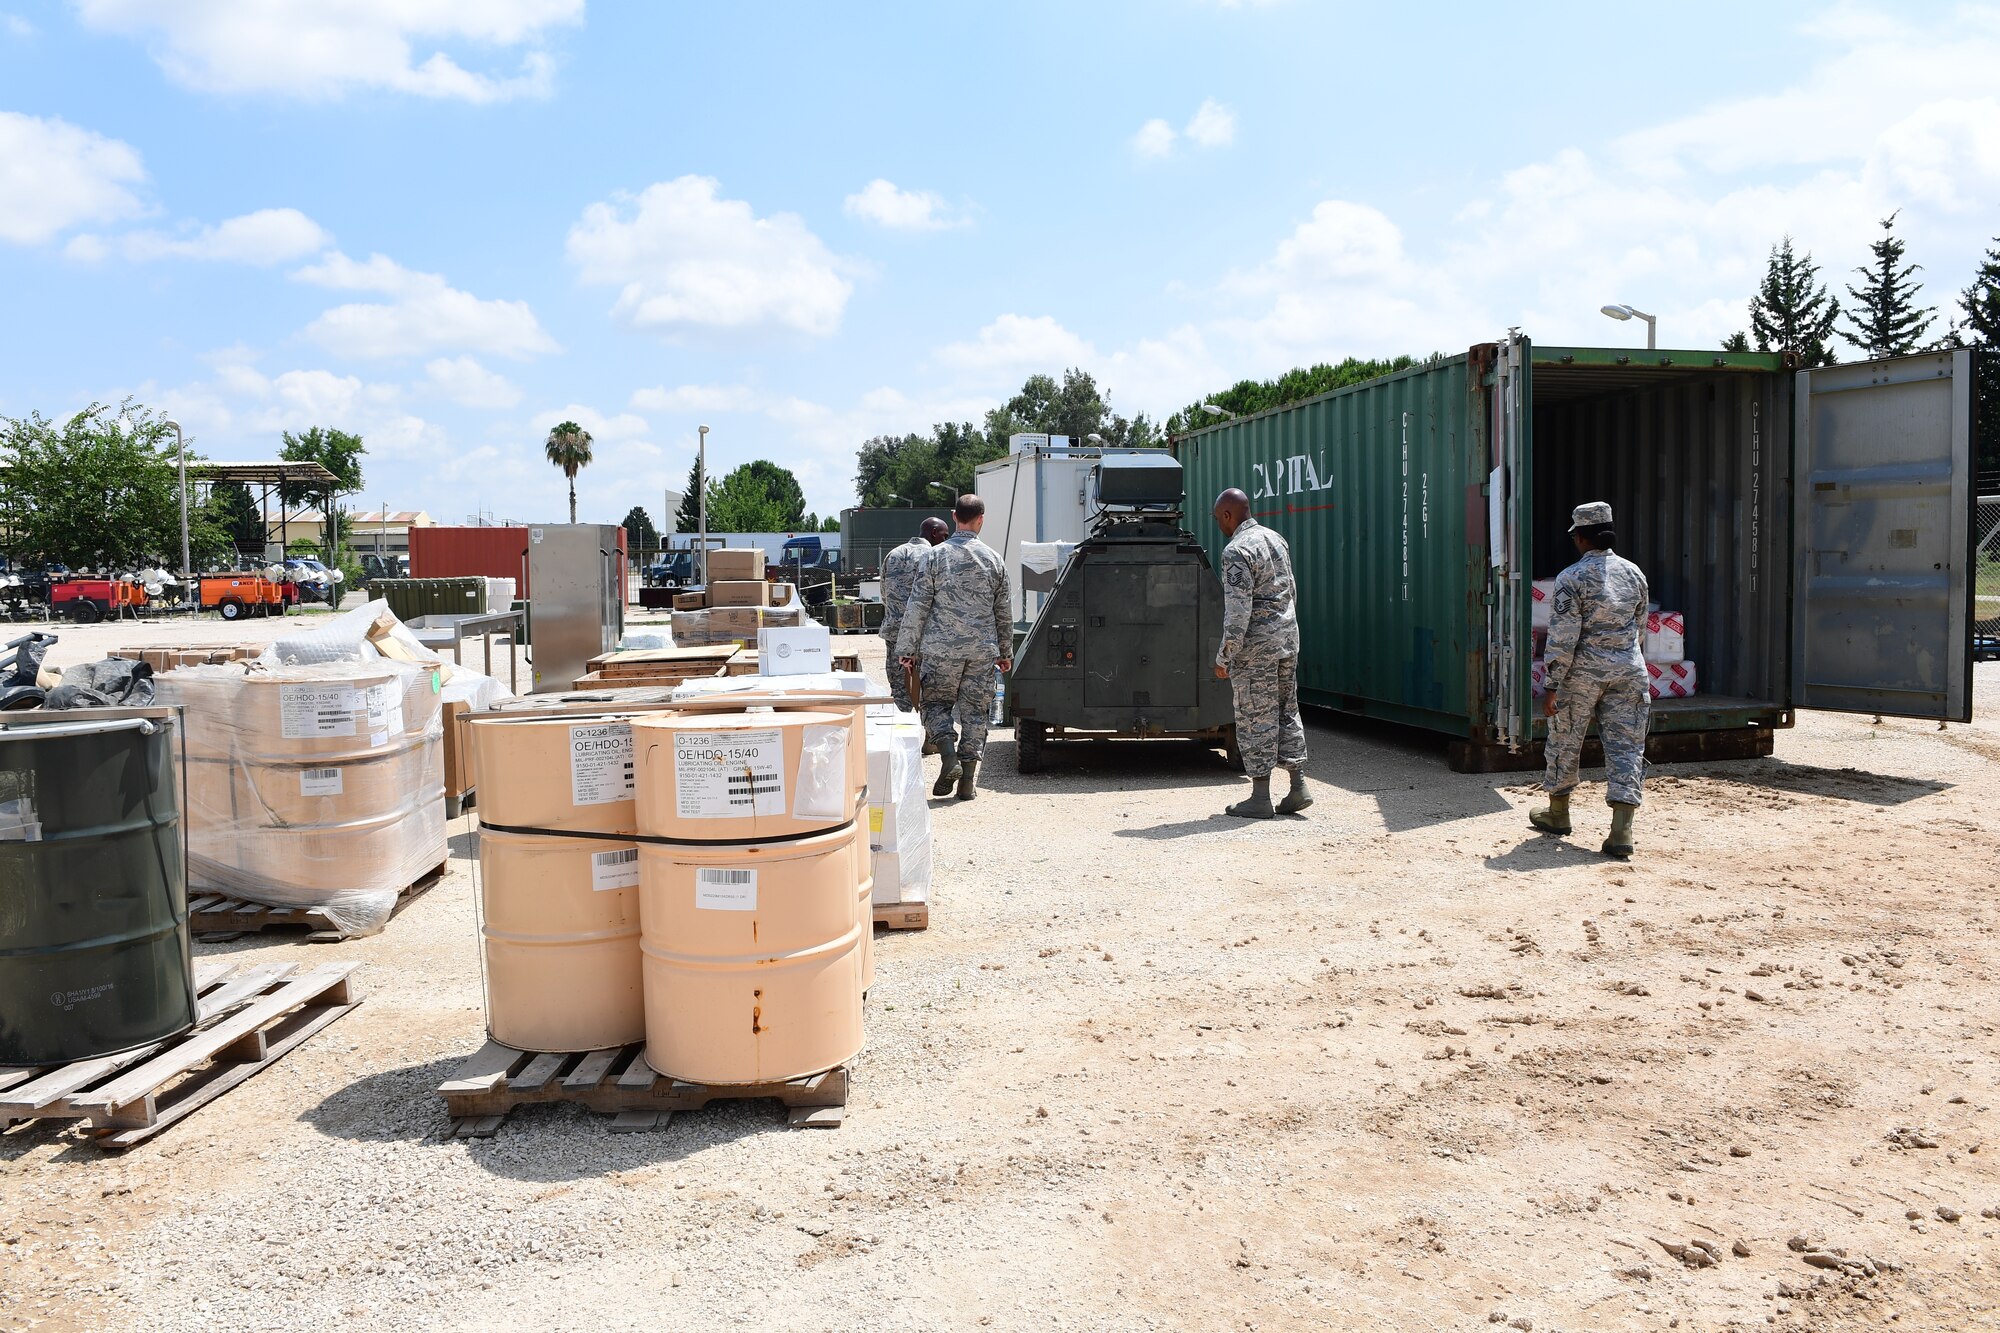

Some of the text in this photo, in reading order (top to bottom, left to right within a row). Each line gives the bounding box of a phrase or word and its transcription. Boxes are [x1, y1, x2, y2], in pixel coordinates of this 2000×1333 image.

[1253, 450, 1333, 499] CAPITAL
[1751, 472, 1759, 568] 274580
[283, 693, 339, 701] OE/HDO-15/40
[575, 728, 608, 738] O-1236
[678, 737, 710, 745] O-1236
[678, 748, 759, 760] OE/HDO-15/40
